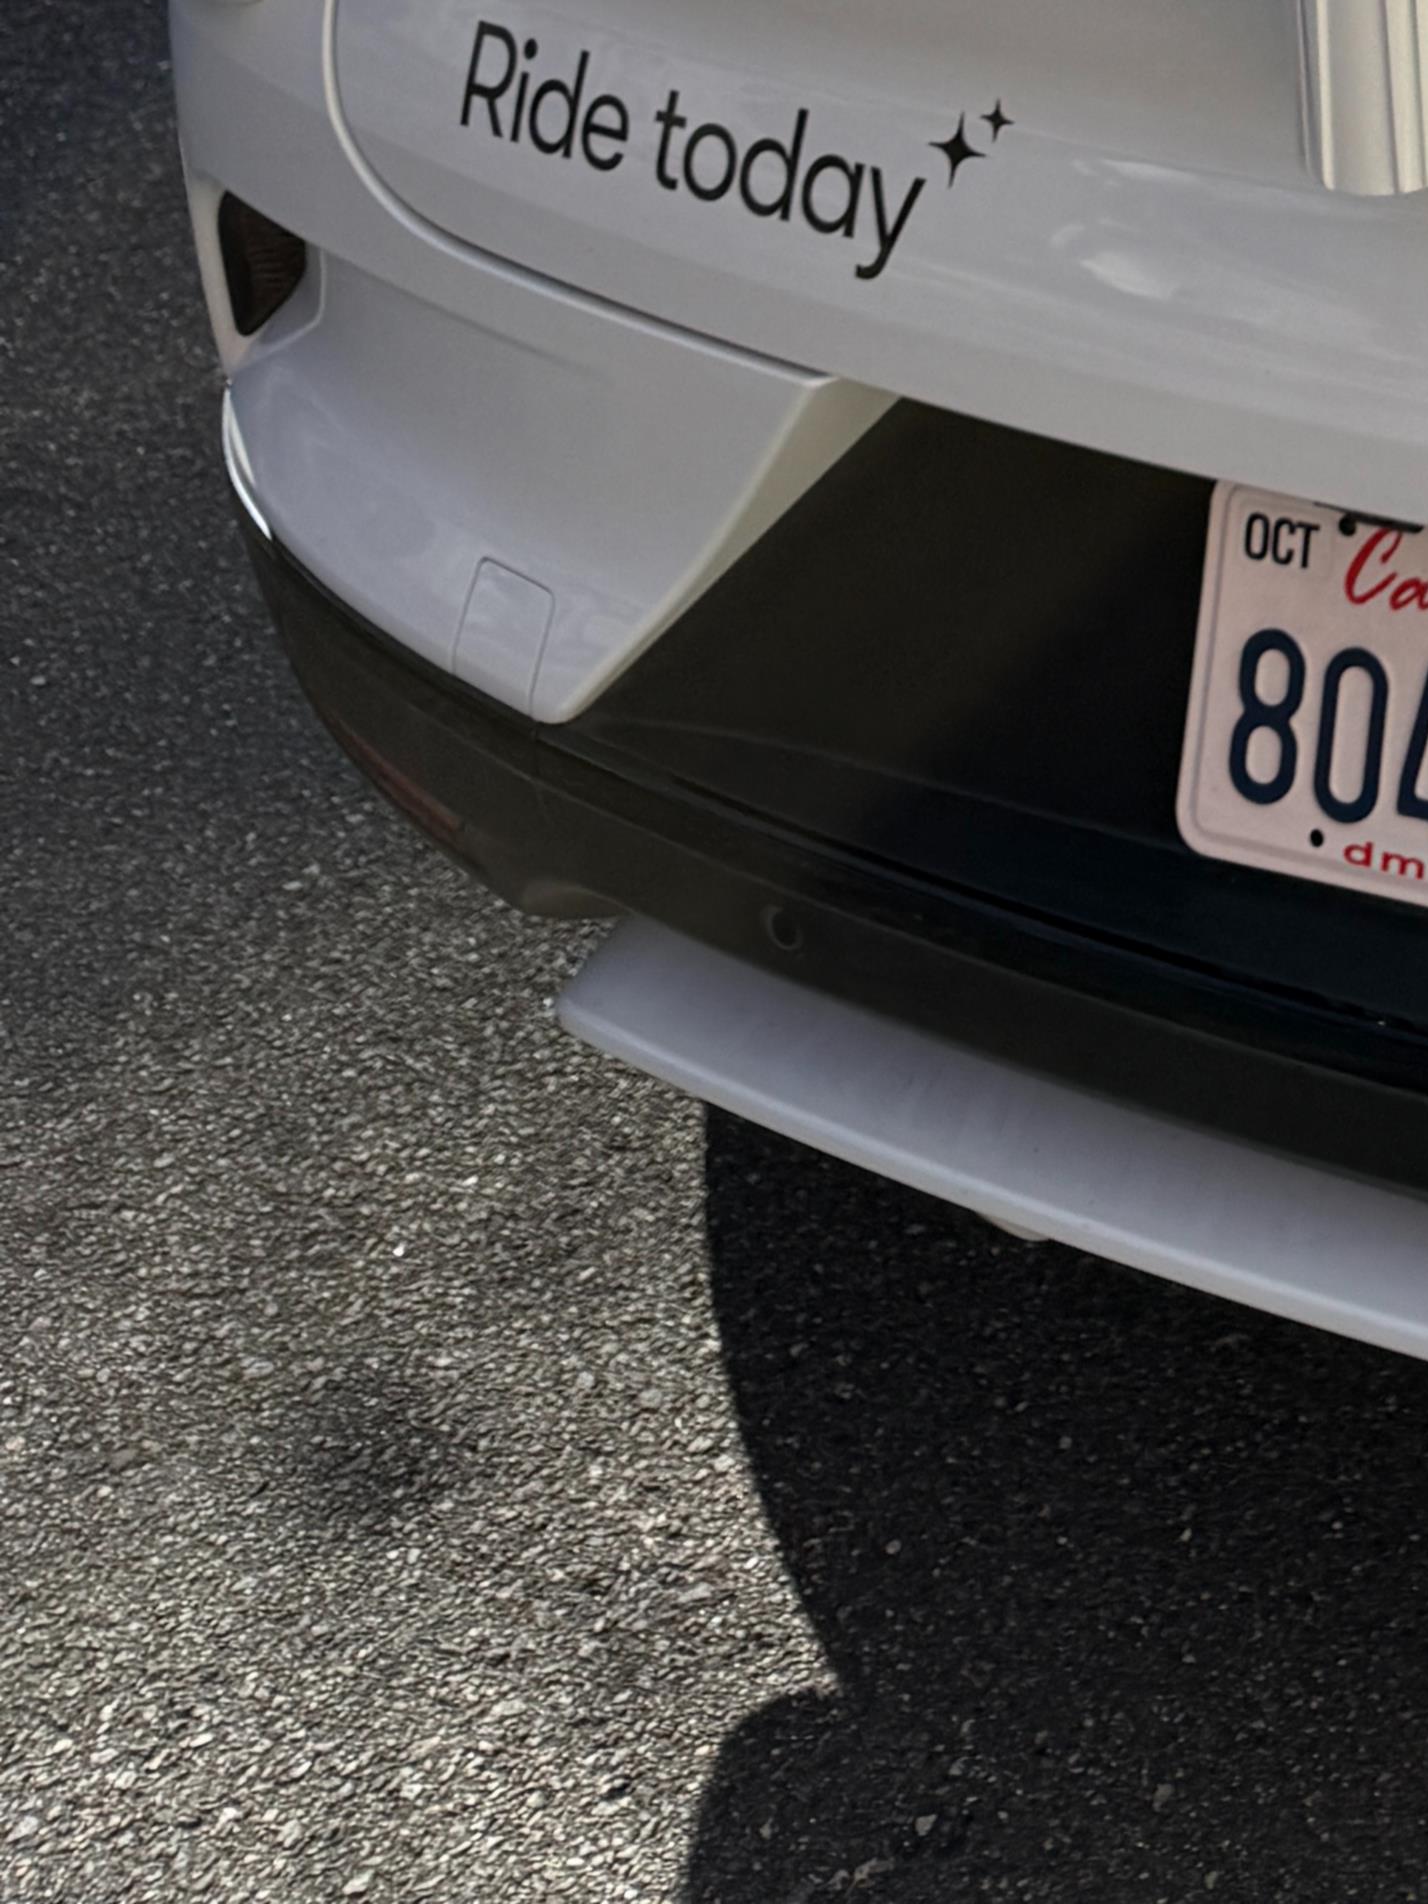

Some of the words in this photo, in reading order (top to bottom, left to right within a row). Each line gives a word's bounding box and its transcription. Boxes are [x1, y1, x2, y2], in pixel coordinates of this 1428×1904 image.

[459, 20, 630, 171] Ride
[655, 90, 926, 279] today
[1244, 513, 1321, 569] OCT
